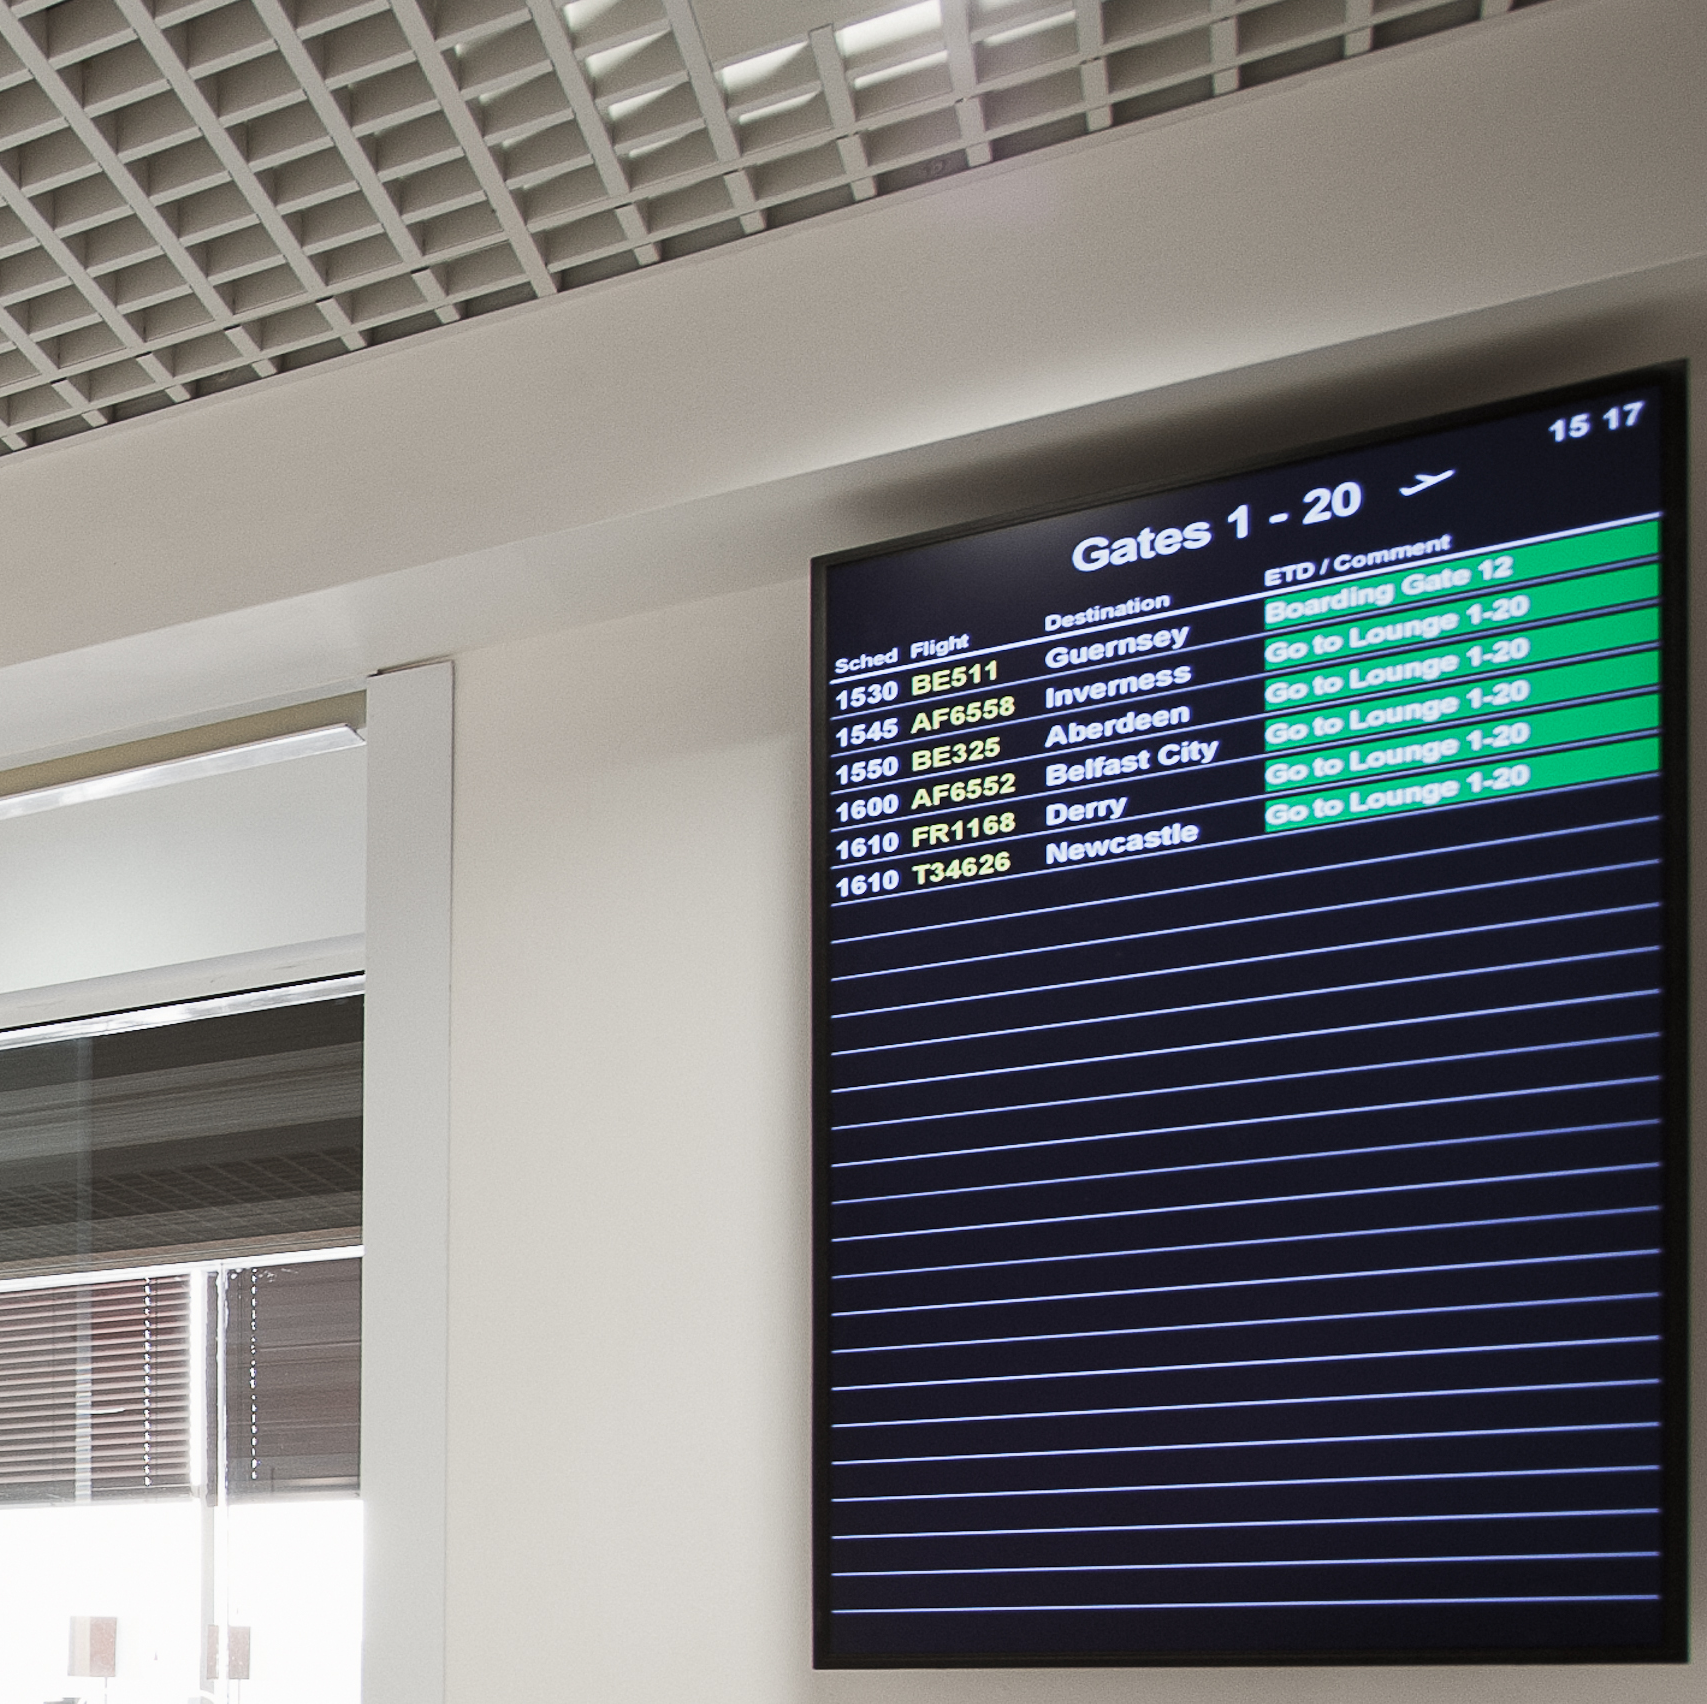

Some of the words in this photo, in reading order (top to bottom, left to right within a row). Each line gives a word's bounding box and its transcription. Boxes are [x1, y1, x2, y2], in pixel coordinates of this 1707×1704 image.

[1550, 414, 1589, 441] 15
[1604, 402, 1642, 429] 17
[1072, 522, 1211, 571] Gates
[1228, 505, 1248, 538] 1
[1269, 513, 1288, 523] -
[1303, 482, 1361, 524] 20
[835, 648, 898, 673] Sched
[911, 634, 969, 658] Flight
[1045, 595, 1170, 631] Destination
[1265, 562, 1315, 586] ETD
[1320, 559, 1329, 575] /
[1334, 535, 1450, 572] Comment
[836, 681, 898, 710] 1530
[912, 660, 996, 695] BE511
[1045, 627, 1189, 668] Guernsey
[1266, 584, 1394, 625] Boarding
[1402, 568, 1471, 595] Gate
[1478, 556, 1513, 580] 12
[836, 718, 898, 747] 1545
[911, 696, 1015, 734] AF6558
[1046, 666, 1191, 708] Inverness
[1265, 642, 1308, 662] Go
[1312, 635, 1343, 654] to
[1350, 613, 1459, 648] Lounge
[1466, 596, 1529, 624] 1-20
[836, 756, 898, 784] 1550
[913, 737, 1000, 771] BE325
[1045, 706, 1190, 747] Aberdeen
[1265, 682, 1308, 703] Go
[1312, 676, 1343, 695] to
[1350, 655, 1459, 695] Lounge
[1466, 638, 1529, 666] 1-20
[836, 794, 898, 822] 1600
[911, 773, 1015, 809] AF6552
[1046, 750, 1150, 786] Belfast
[1158, 741, 1219, 765] City
[1265, 723, 1309, 744] Go
[1312, 717, 1344, 736] to
[1350, 697, 1459, 735] Lounge
[1466, 680, 1529, 708] 1-20
[836, 832, 899, 859] 1610
[913, 812, 1015, 847] FR1168
[1046, 796, 1126, 830] Derry
[1266, 764, 1309, 784] Go
[1312, 758, 1344, 777] to
[1350, 738, 1460, 776] Lounge
[1466, 723, 1529, 750] 1-20
[836, 870, 899, 897] 1610
[912, 852, 1010, 884] T34626
[1046, 823, 1199, 864] Newcastle
[1266, 804, 1309, 825] Go
[1312, 799, 1344, 818] to
[1350, 780, 1460, 819] Lounge
[1466, 765, 1529, 792] 1-20
